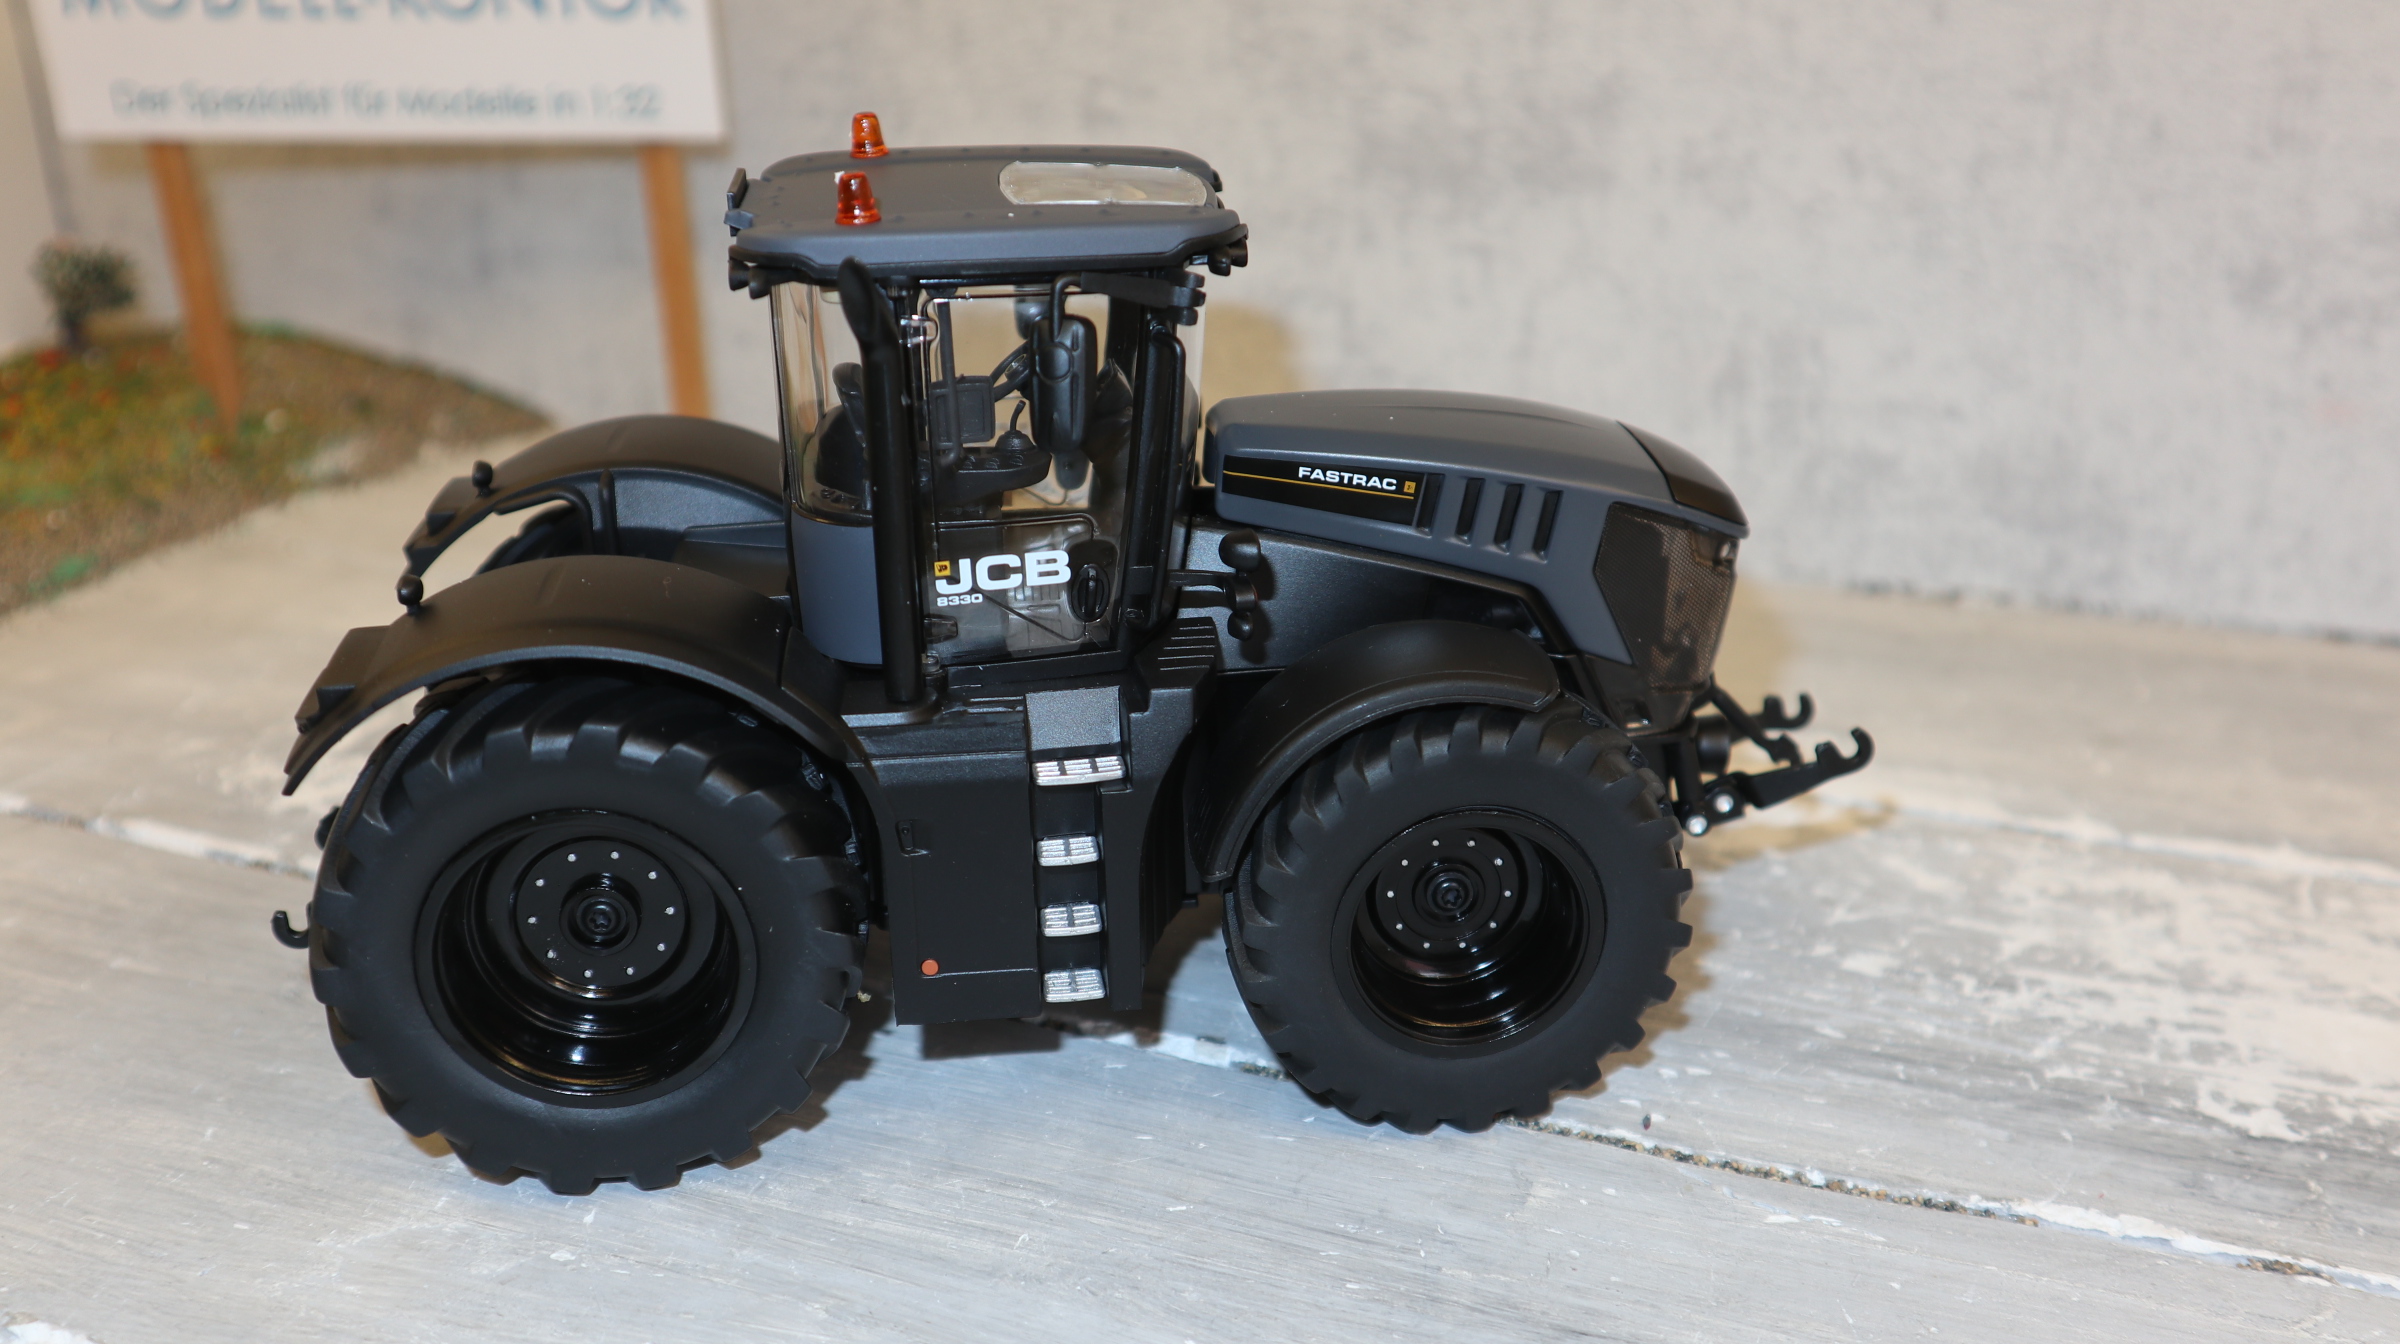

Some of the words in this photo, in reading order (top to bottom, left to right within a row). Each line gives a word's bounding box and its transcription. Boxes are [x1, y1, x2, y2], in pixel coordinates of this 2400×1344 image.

[1298, 466, 1397, 490] FASTRAC
[935, 550, 1071, 594] JCB
[937, 593, 983, 607] 8330
